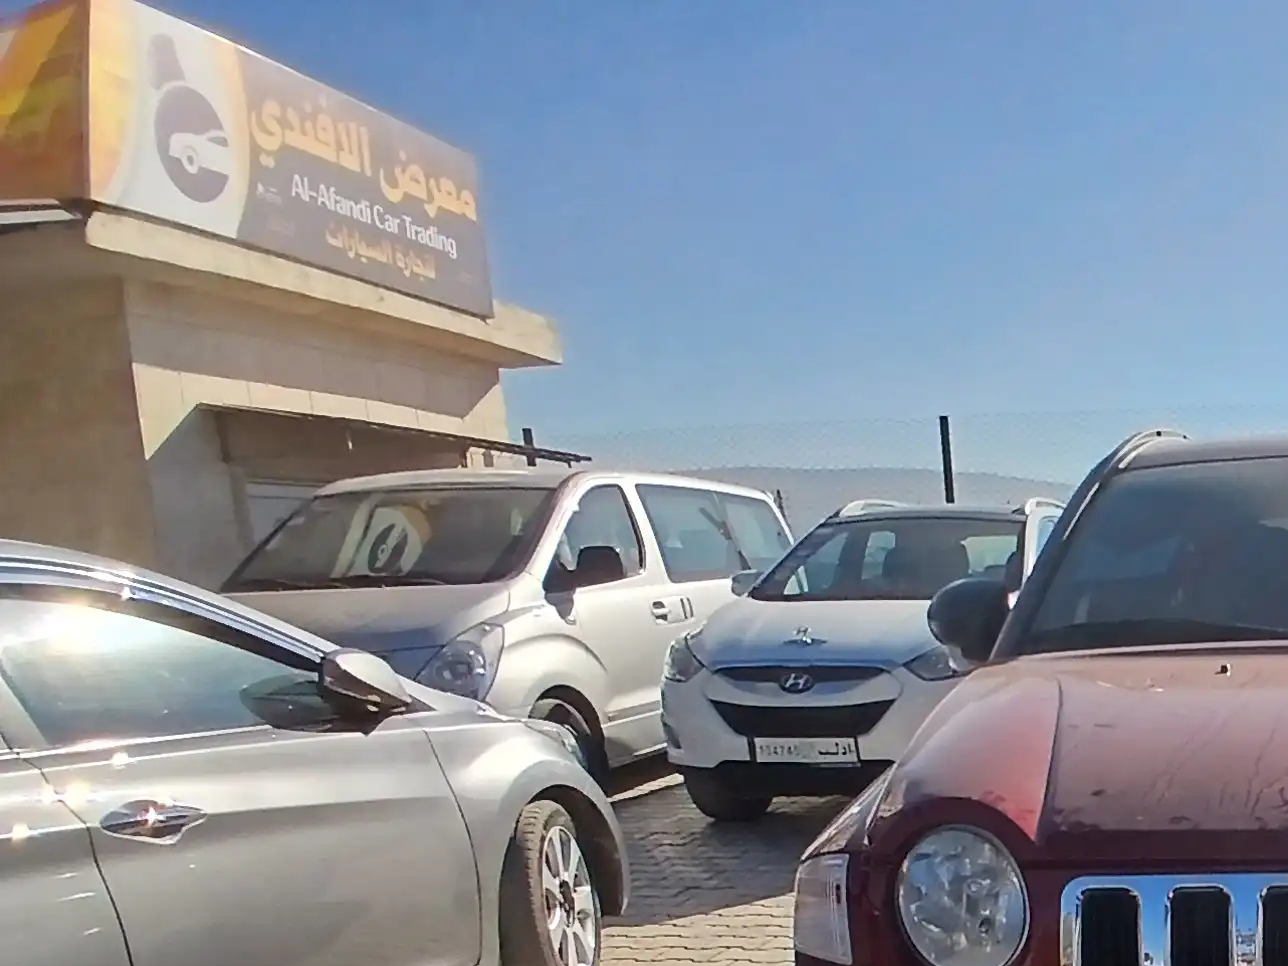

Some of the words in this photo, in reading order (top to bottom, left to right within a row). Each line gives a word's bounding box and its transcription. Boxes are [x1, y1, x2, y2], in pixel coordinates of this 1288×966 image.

[291, 174, 372, 225] Al-Afandi
[374, 205, 400, 233] Car
[402, 215, 457, 259] Trading
[380, 151, 477, 221] معرض
